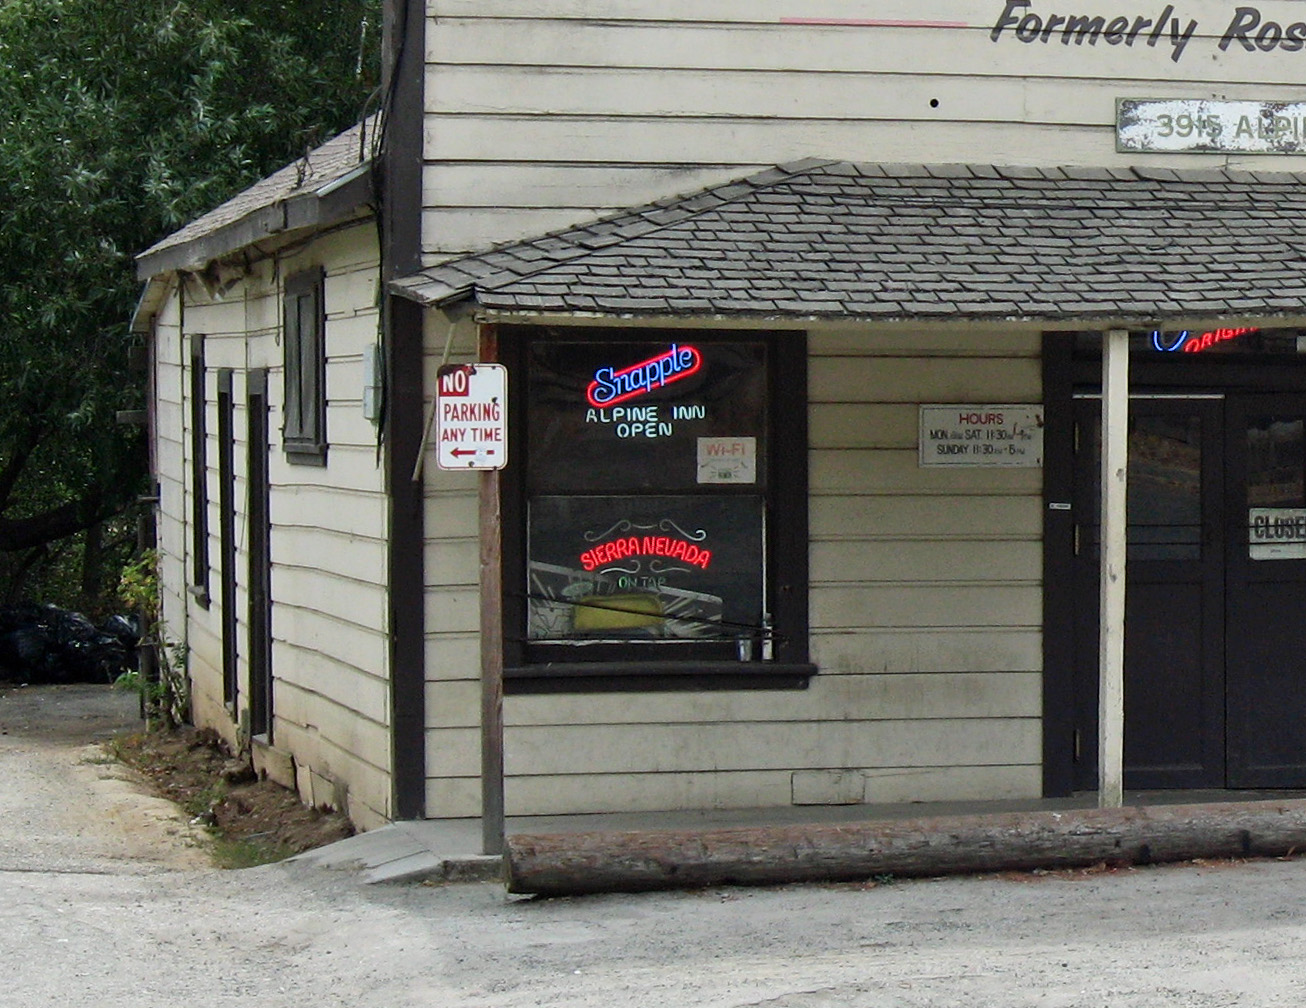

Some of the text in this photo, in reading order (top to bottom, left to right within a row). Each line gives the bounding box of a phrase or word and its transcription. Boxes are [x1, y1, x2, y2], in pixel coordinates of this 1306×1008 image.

[990, 0, 1198, 62] Formerly
[1156, 114, 1223, 138] 3915
[443, 370, 466, 393] NO
[593, 343, 693, 403] Snapple
[443, 403, 500, 422] PARKING
[585, 405, 706, 423] ALPINE INN
[959, 413, 1004, 425] HOURS
[442, 427, 502, 442] ANY TIME
[616, 422, 673, 438] OPEN
[936, 444, 969, 455] SUNDAY
[580, 536, 713, 572] SIERRA NEVADA
[618, 576, 638, 589] ON
